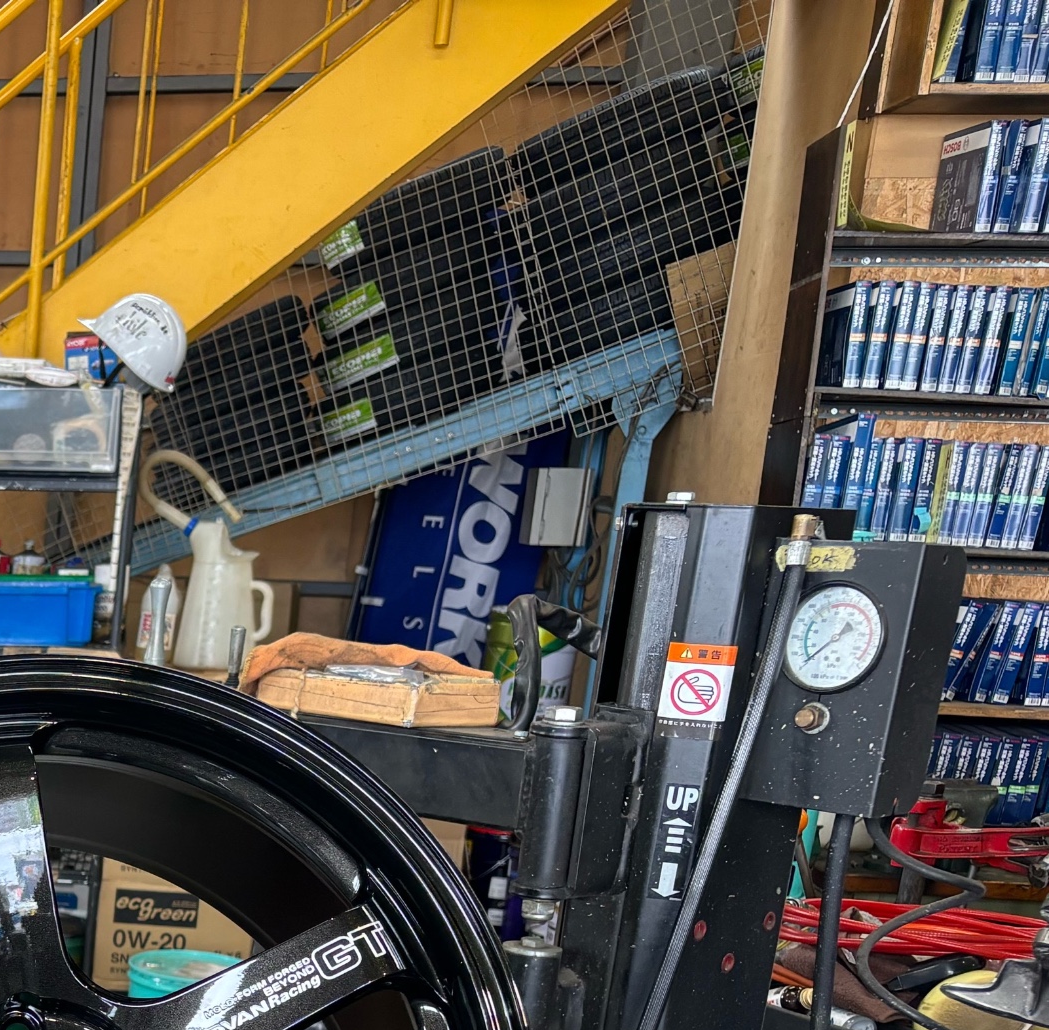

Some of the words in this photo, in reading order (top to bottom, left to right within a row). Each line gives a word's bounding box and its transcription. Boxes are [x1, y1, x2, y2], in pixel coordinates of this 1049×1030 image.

[943, 140, 962, 155] BOSCH
[434, 436, 529, 669] WORK
[698, 649, 722, 660] 警告
[666, 785, 699, 812] UP
[137, 908, 196, 922] green
[113, 929, 187, 950] 0W-20
[311, 921, 386, 980] GT
[203, 978, 268, 1020] MOLD-FORM
[267, 956, 311, 985] FORGED
[263, 963, 315, 997] BEYOND
[269, 974, 321, 1009] Racing
